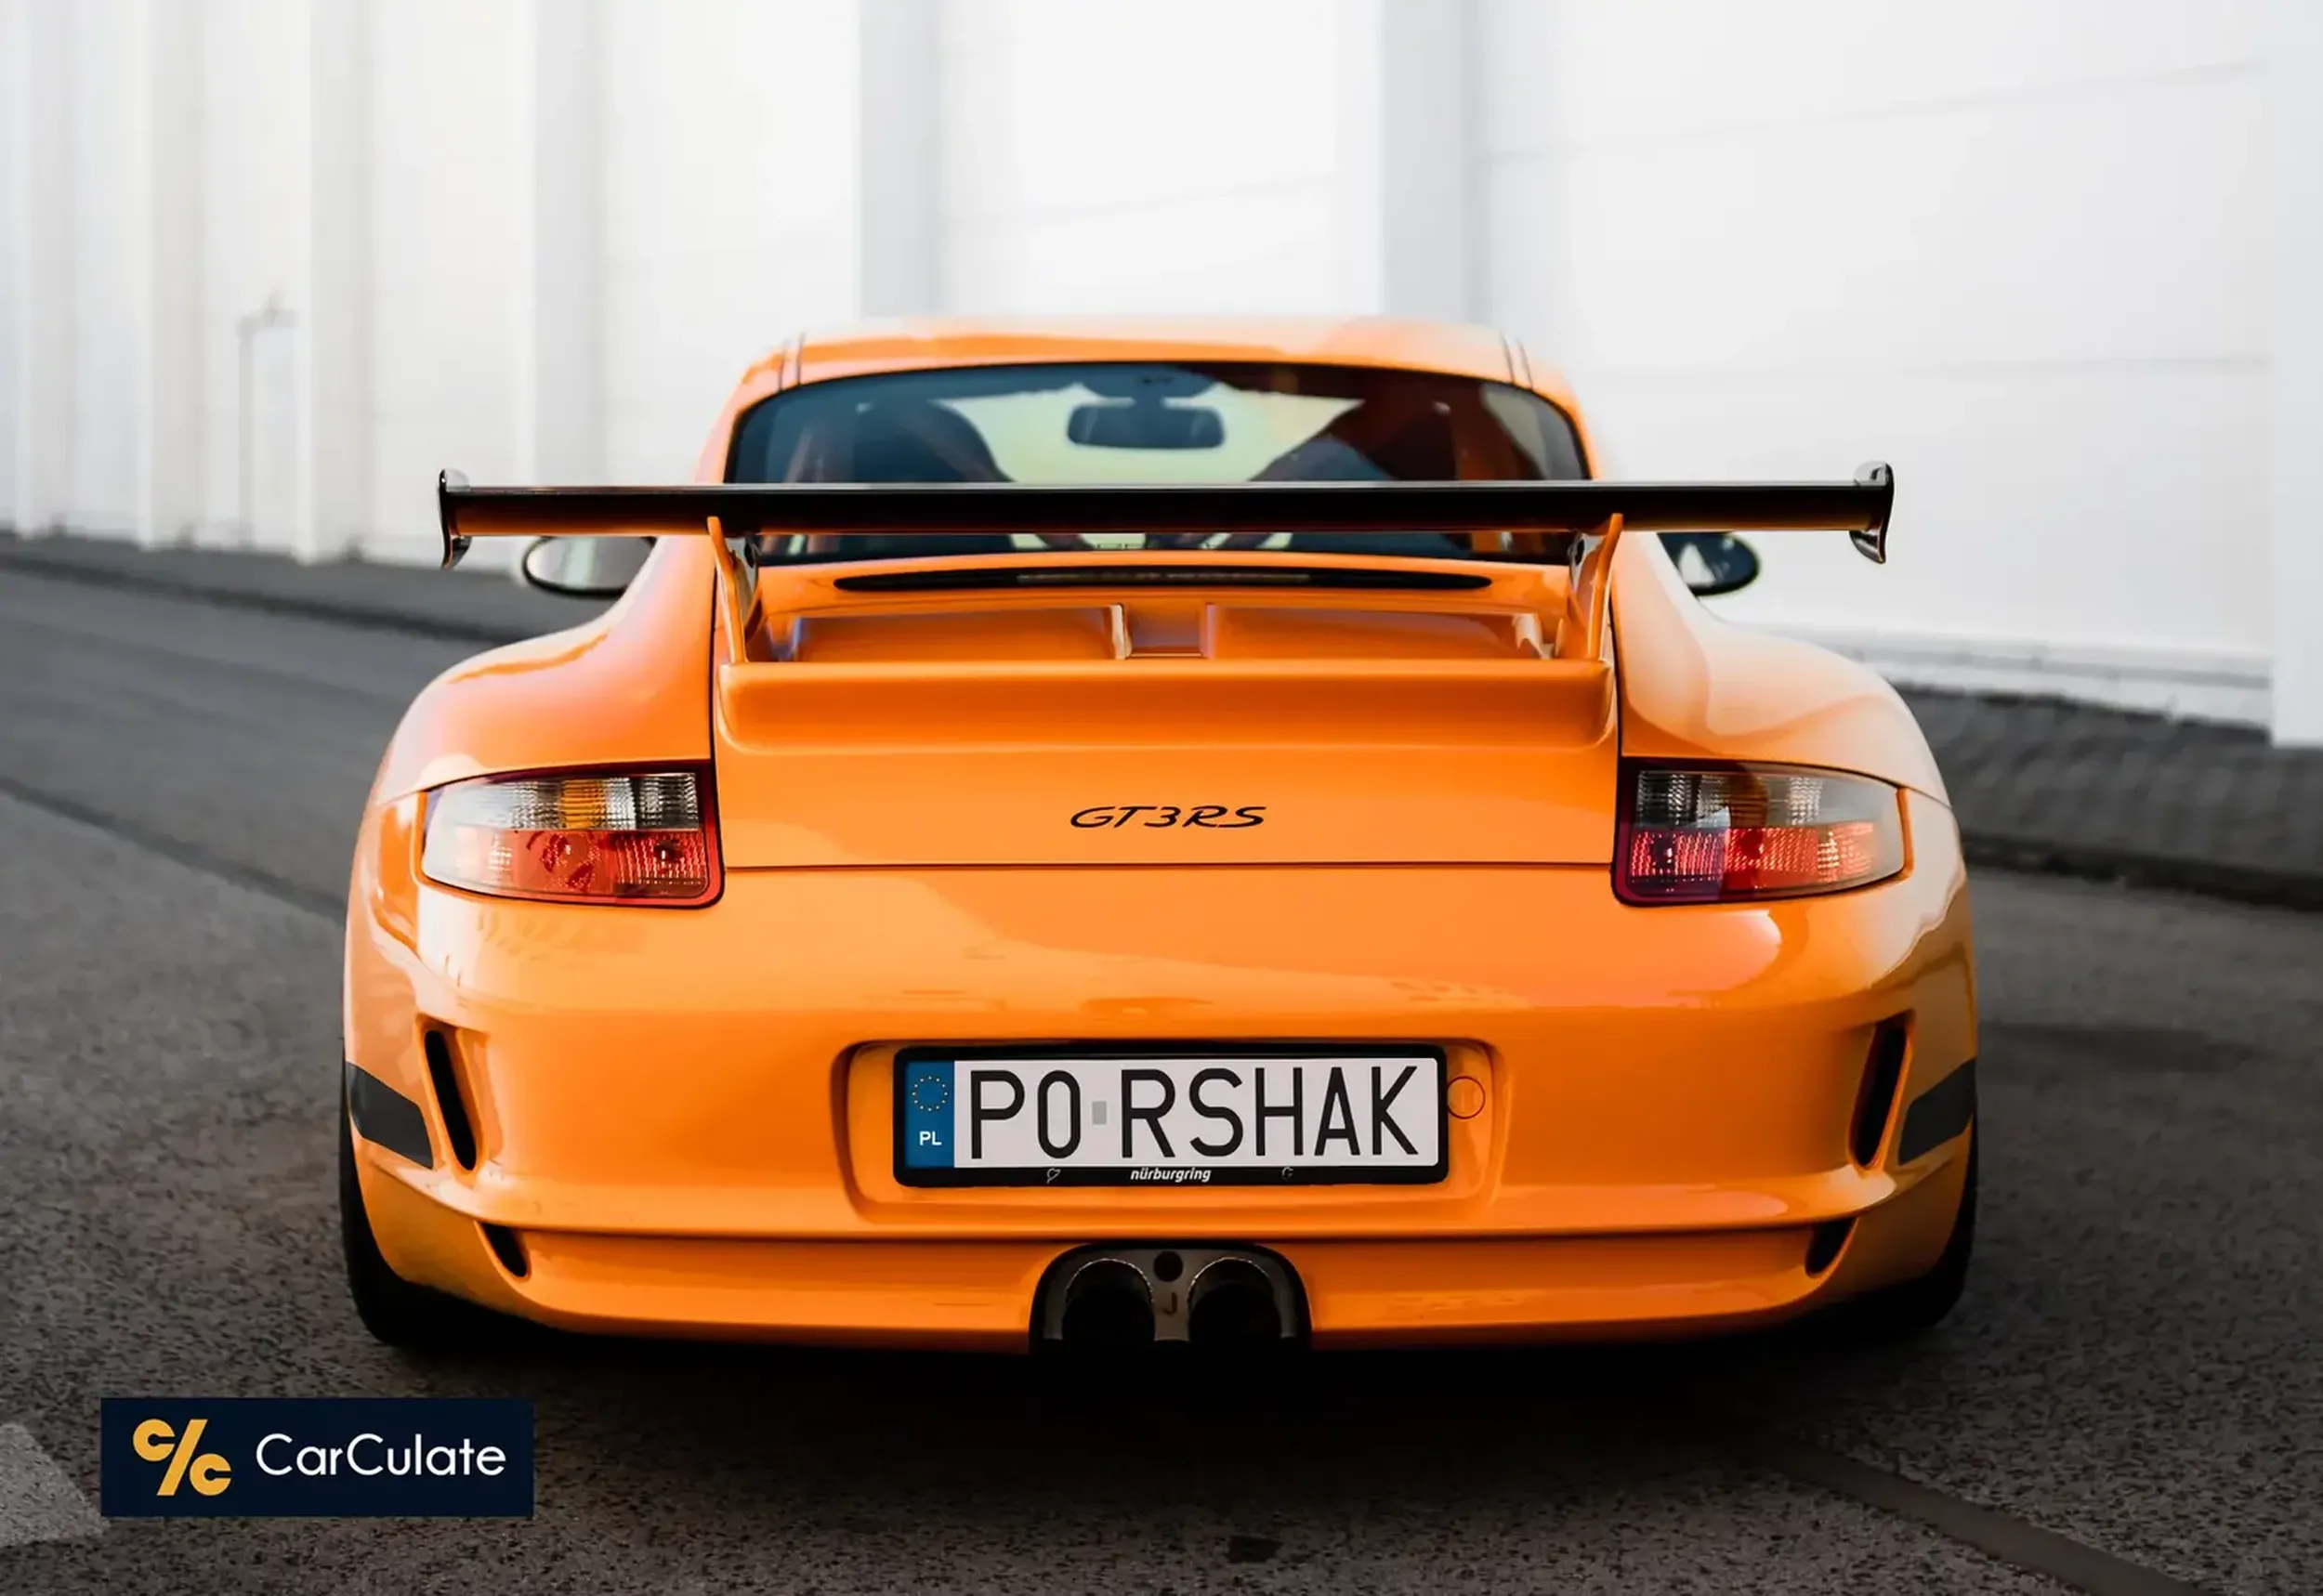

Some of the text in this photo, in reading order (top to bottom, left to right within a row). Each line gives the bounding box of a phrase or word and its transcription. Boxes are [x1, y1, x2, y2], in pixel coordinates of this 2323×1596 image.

[1070, 805, 1267, 828] GT3RS
[1121, 1066, 1419, 1159] RSHAK
[919, 1131, 942, 1145] PL
[1130, 1167, 1212, 1183] nürburgring
